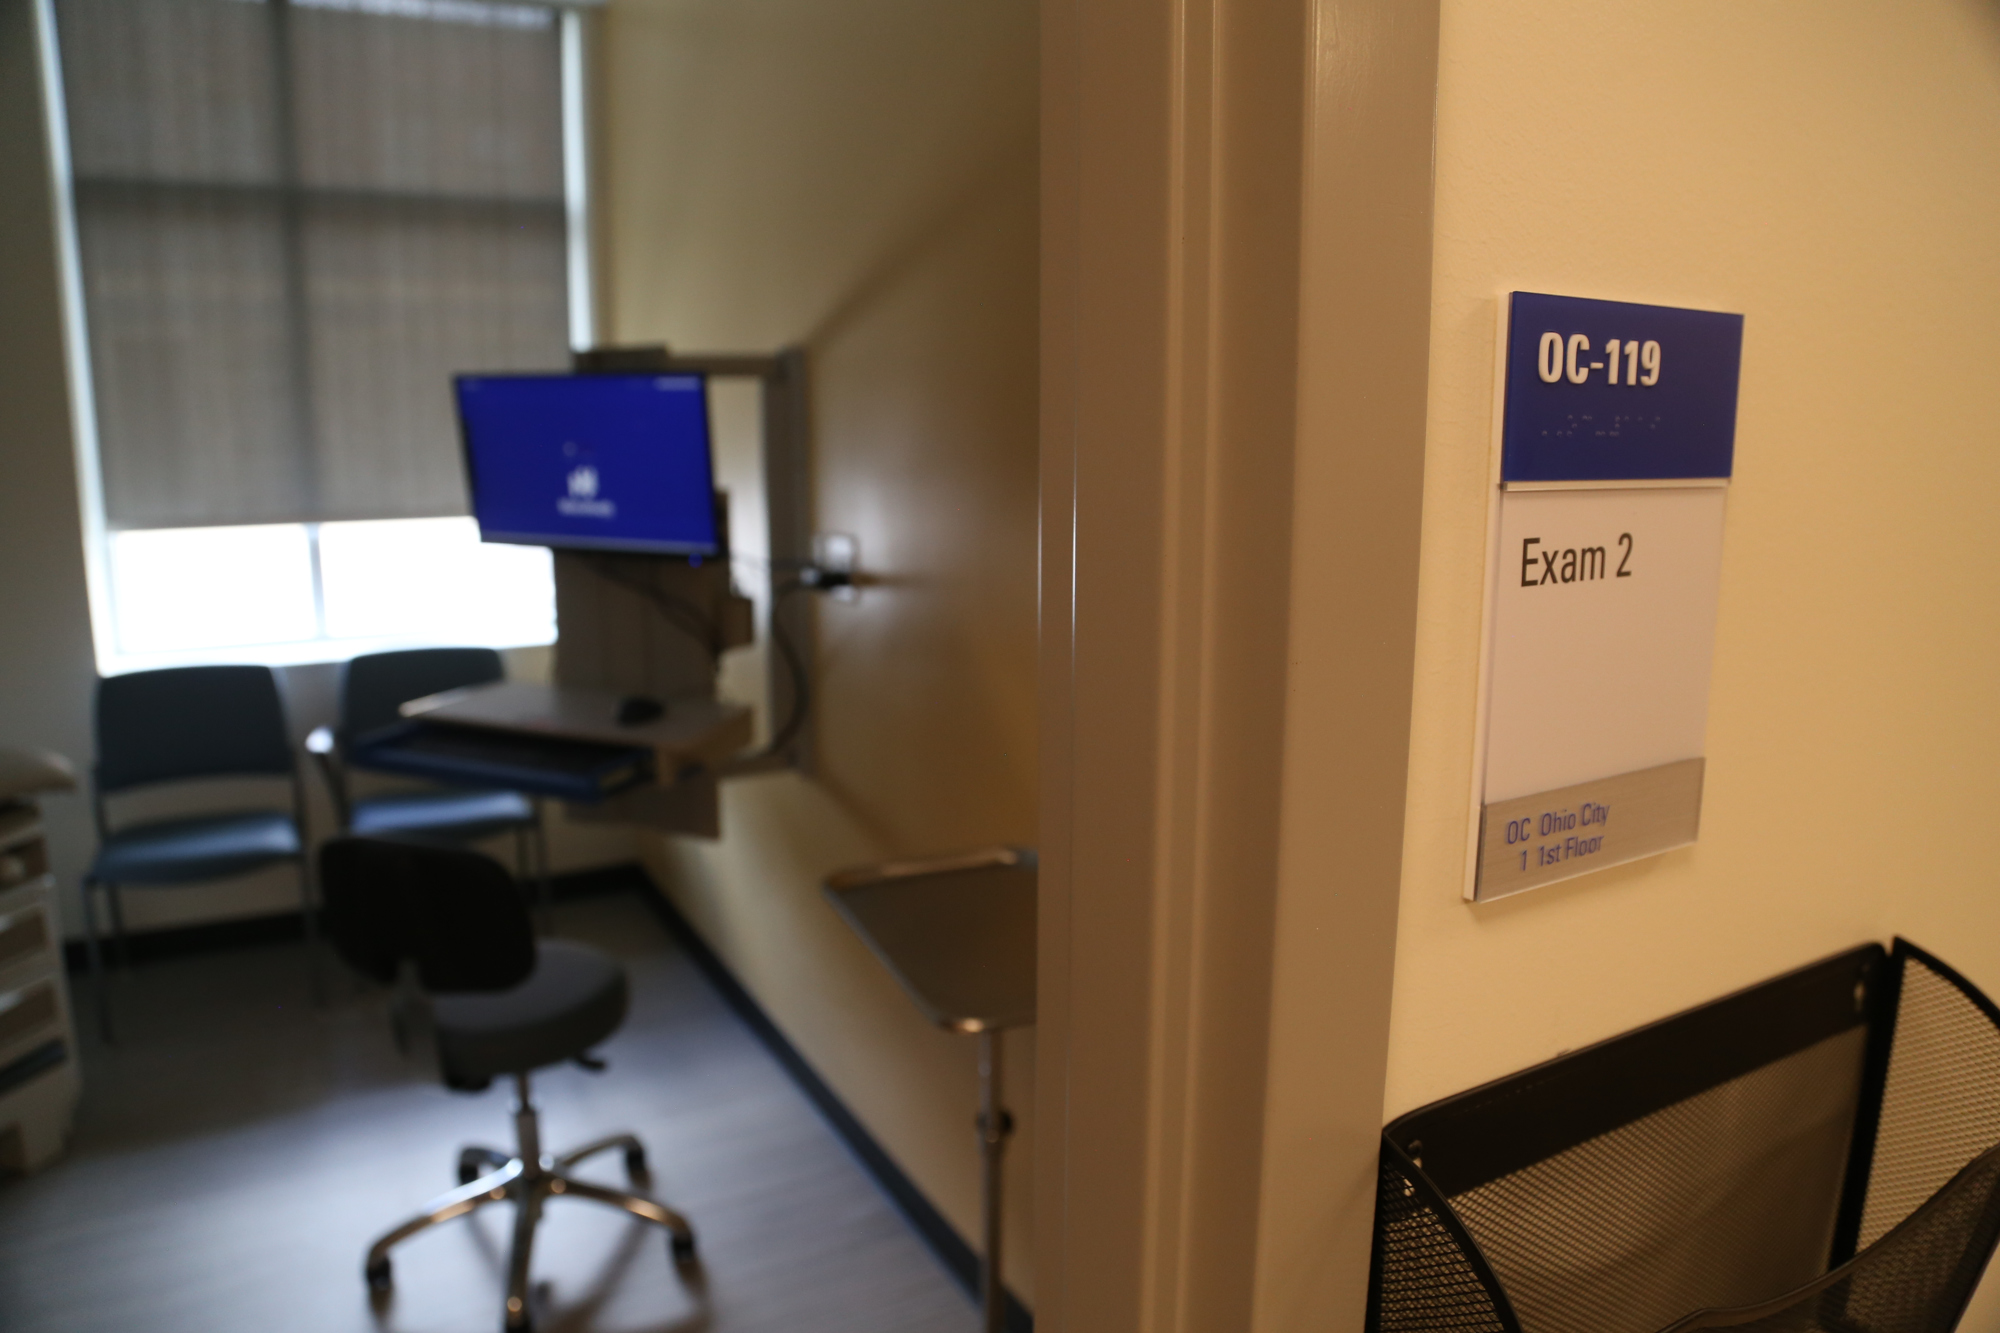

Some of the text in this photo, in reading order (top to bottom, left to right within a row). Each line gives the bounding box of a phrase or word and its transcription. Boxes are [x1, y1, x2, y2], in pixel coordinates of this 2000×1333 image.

[1537, 331, 1661, 387] OC-119
[1520, 532, 1633, 588] Exam 2
[1507, 802, 1610, 845] OC Ohio City
[1520, 835, 1604, 872] 1 1st Floor
